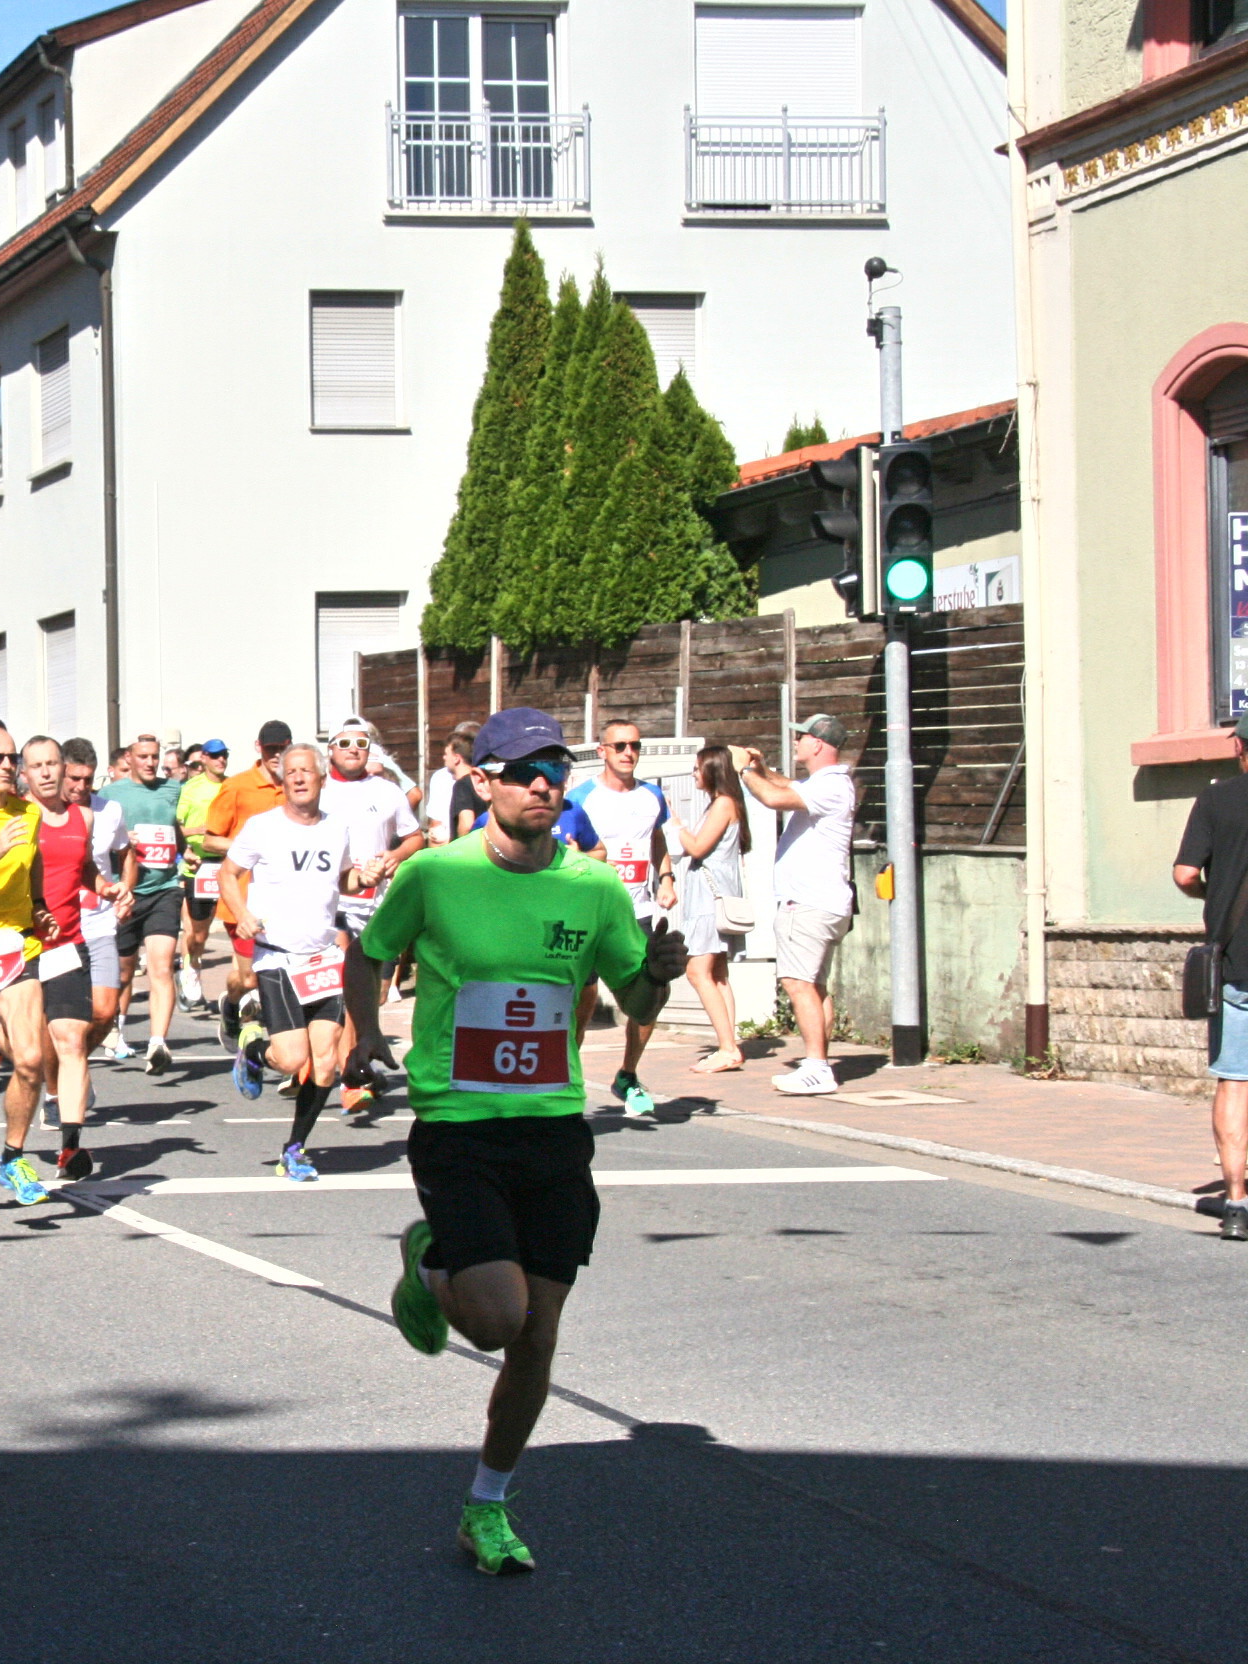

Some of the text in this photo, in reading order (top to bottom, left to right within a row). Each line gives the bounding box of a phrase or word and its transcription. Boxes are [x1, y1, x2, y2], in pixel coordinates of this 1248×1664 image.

[145, 846, 170, 861] 224
[305, 968, 340, 991] 569
[494, 1041, 539, 1075] 65
